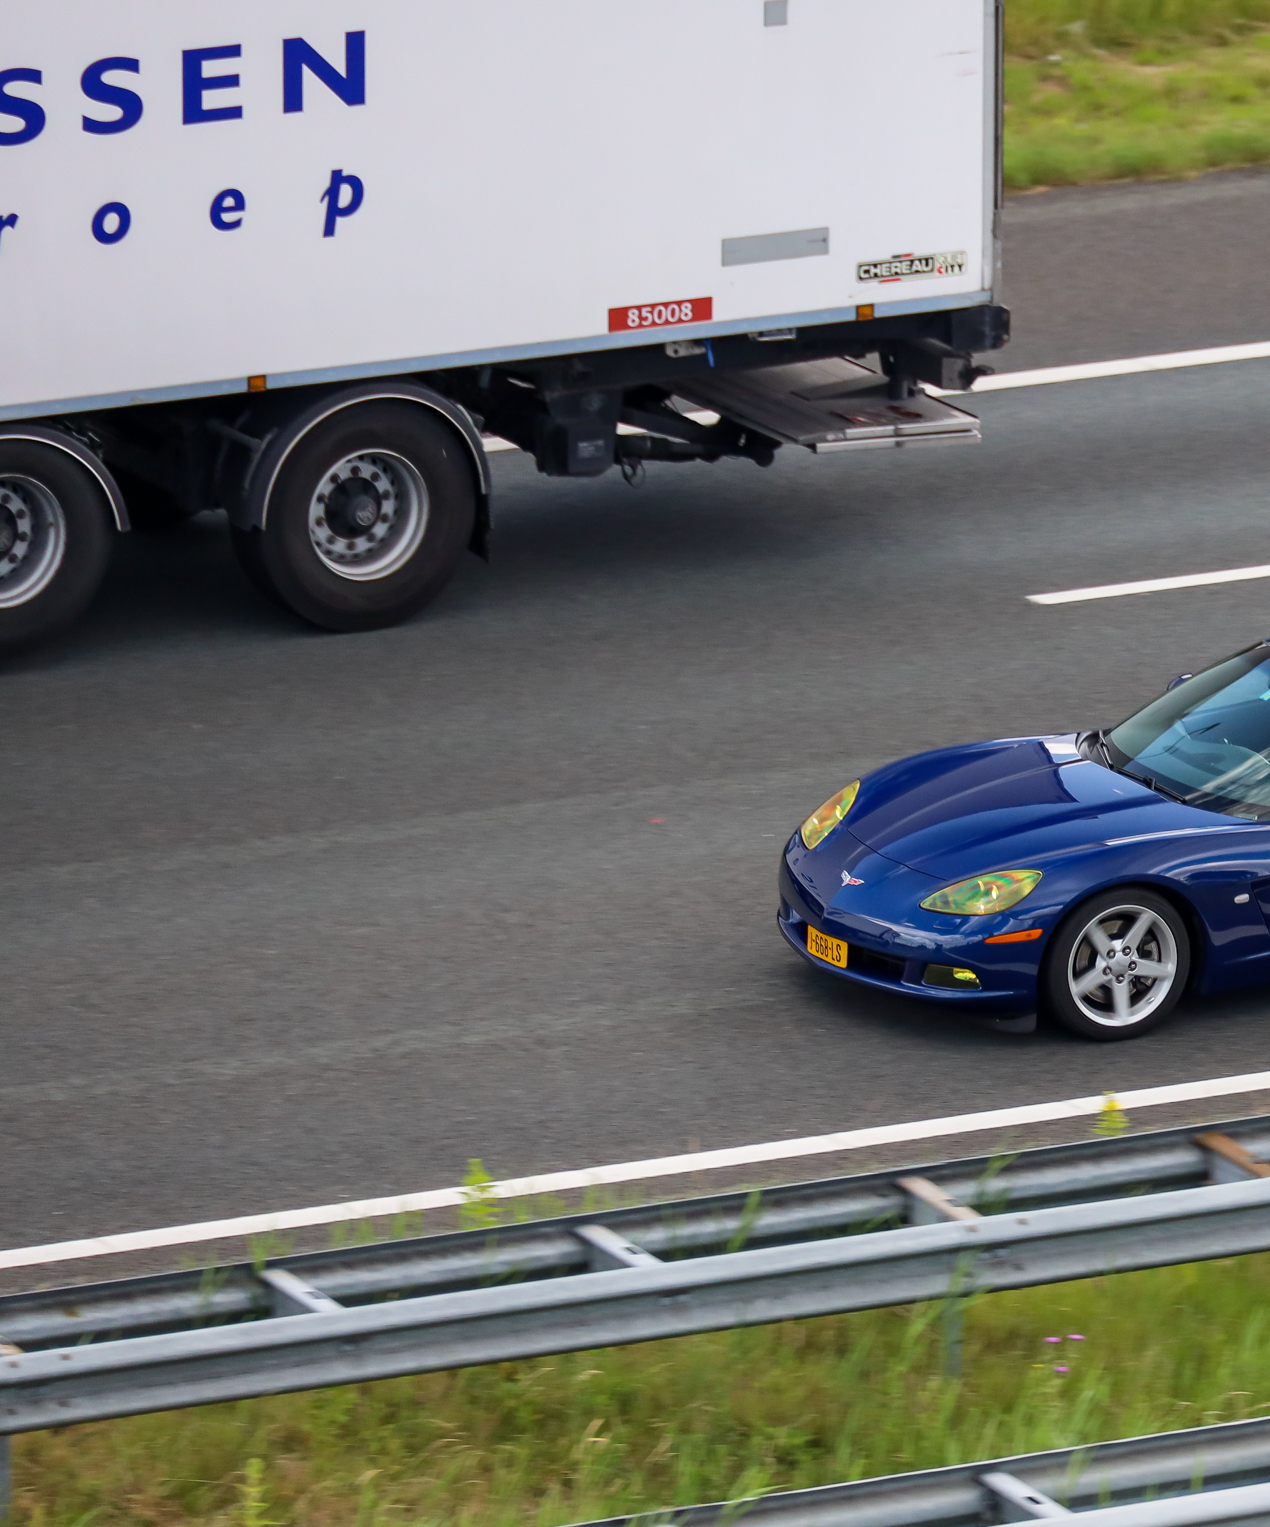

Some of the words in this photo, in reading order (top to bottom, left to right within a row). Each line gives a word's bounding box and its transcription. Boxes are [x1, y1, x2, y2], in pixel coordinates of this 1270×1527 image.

[859, 257, 934, 279] CHEREAU
[936, 263, 965, 275] CITY
[627, 302, 693, 327] 85008
